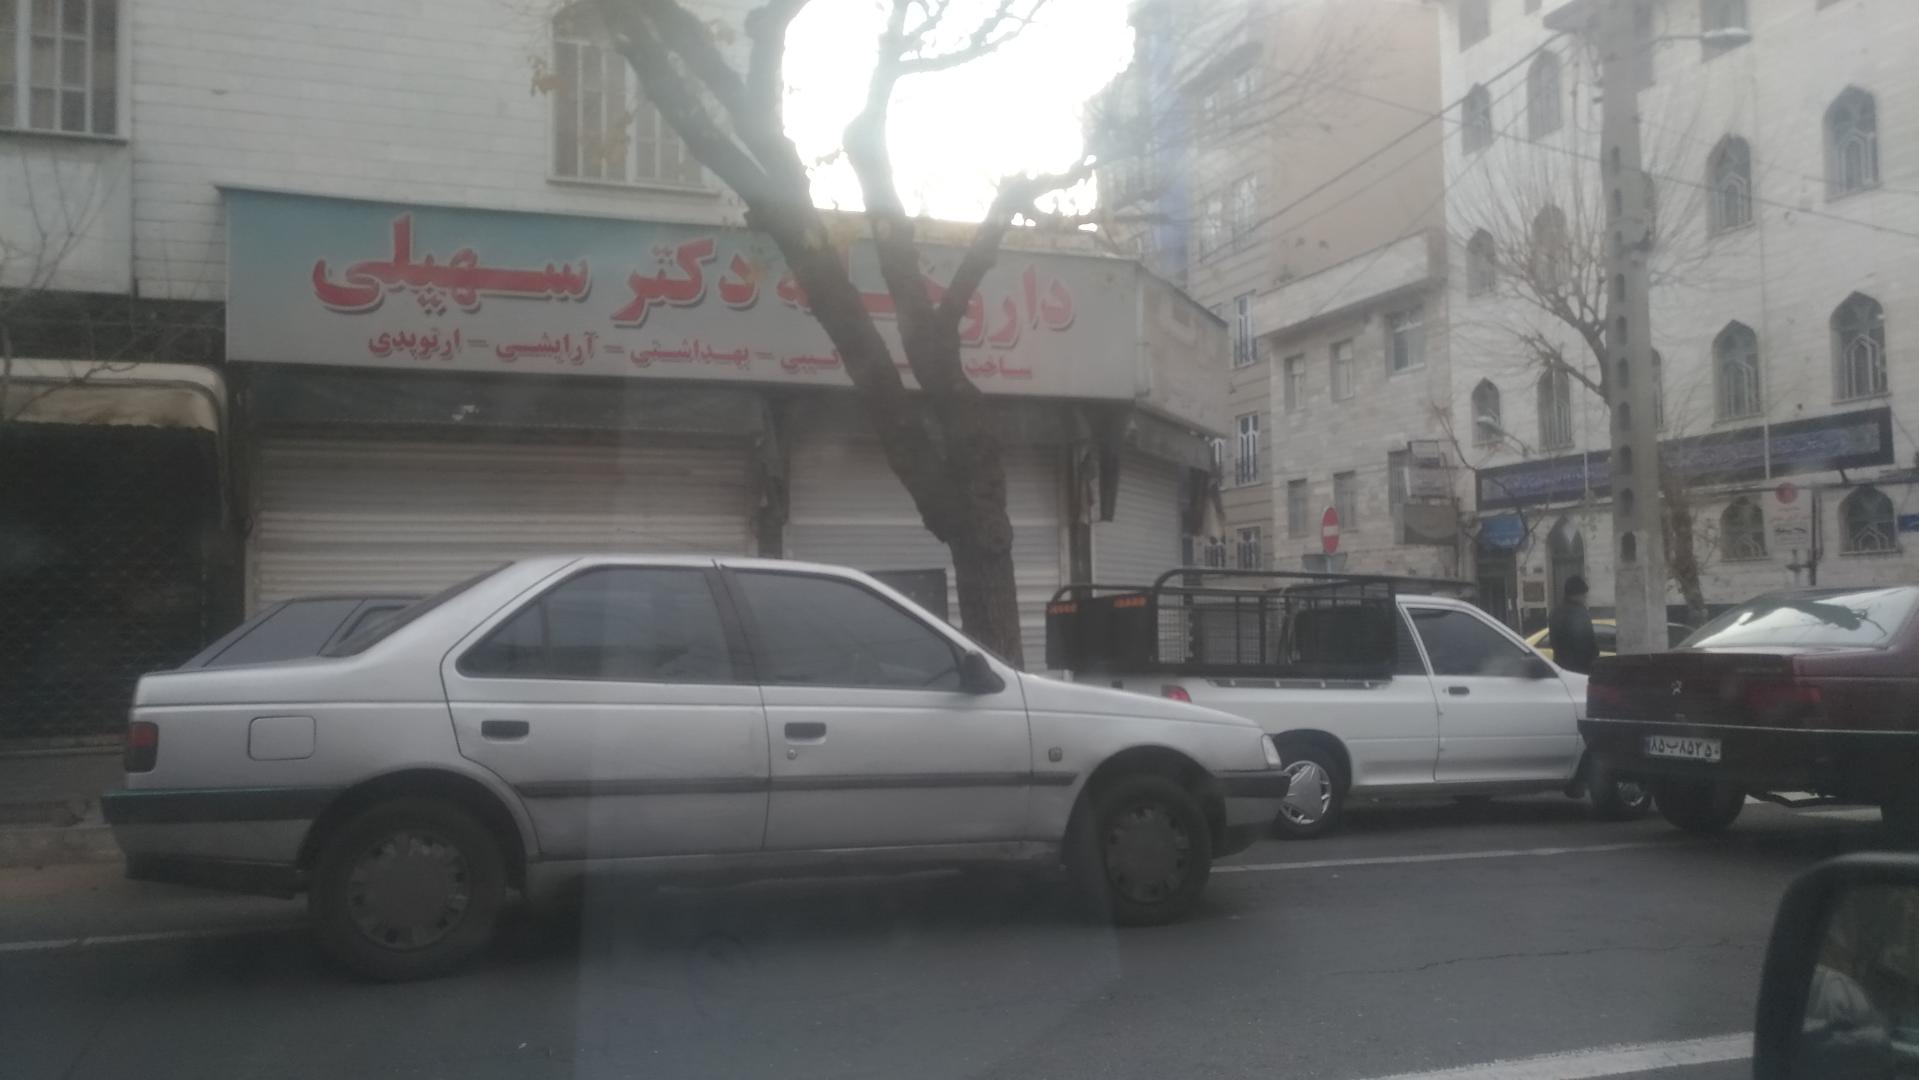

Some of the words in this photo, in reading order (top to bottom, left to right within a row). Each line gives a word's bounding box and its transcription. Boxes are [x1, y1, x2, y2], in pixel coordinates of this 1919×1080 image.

[313, 212, 591, 314] سهیلی
[610, 236, 760, 326] دکتر
[368, 327, 464, 361] ارتوپدی
[496, 331, 598, 365] آرایشی
[630, 339, 751, 370] بهداشتی
[964, 354, 1033, 379] ساخت
